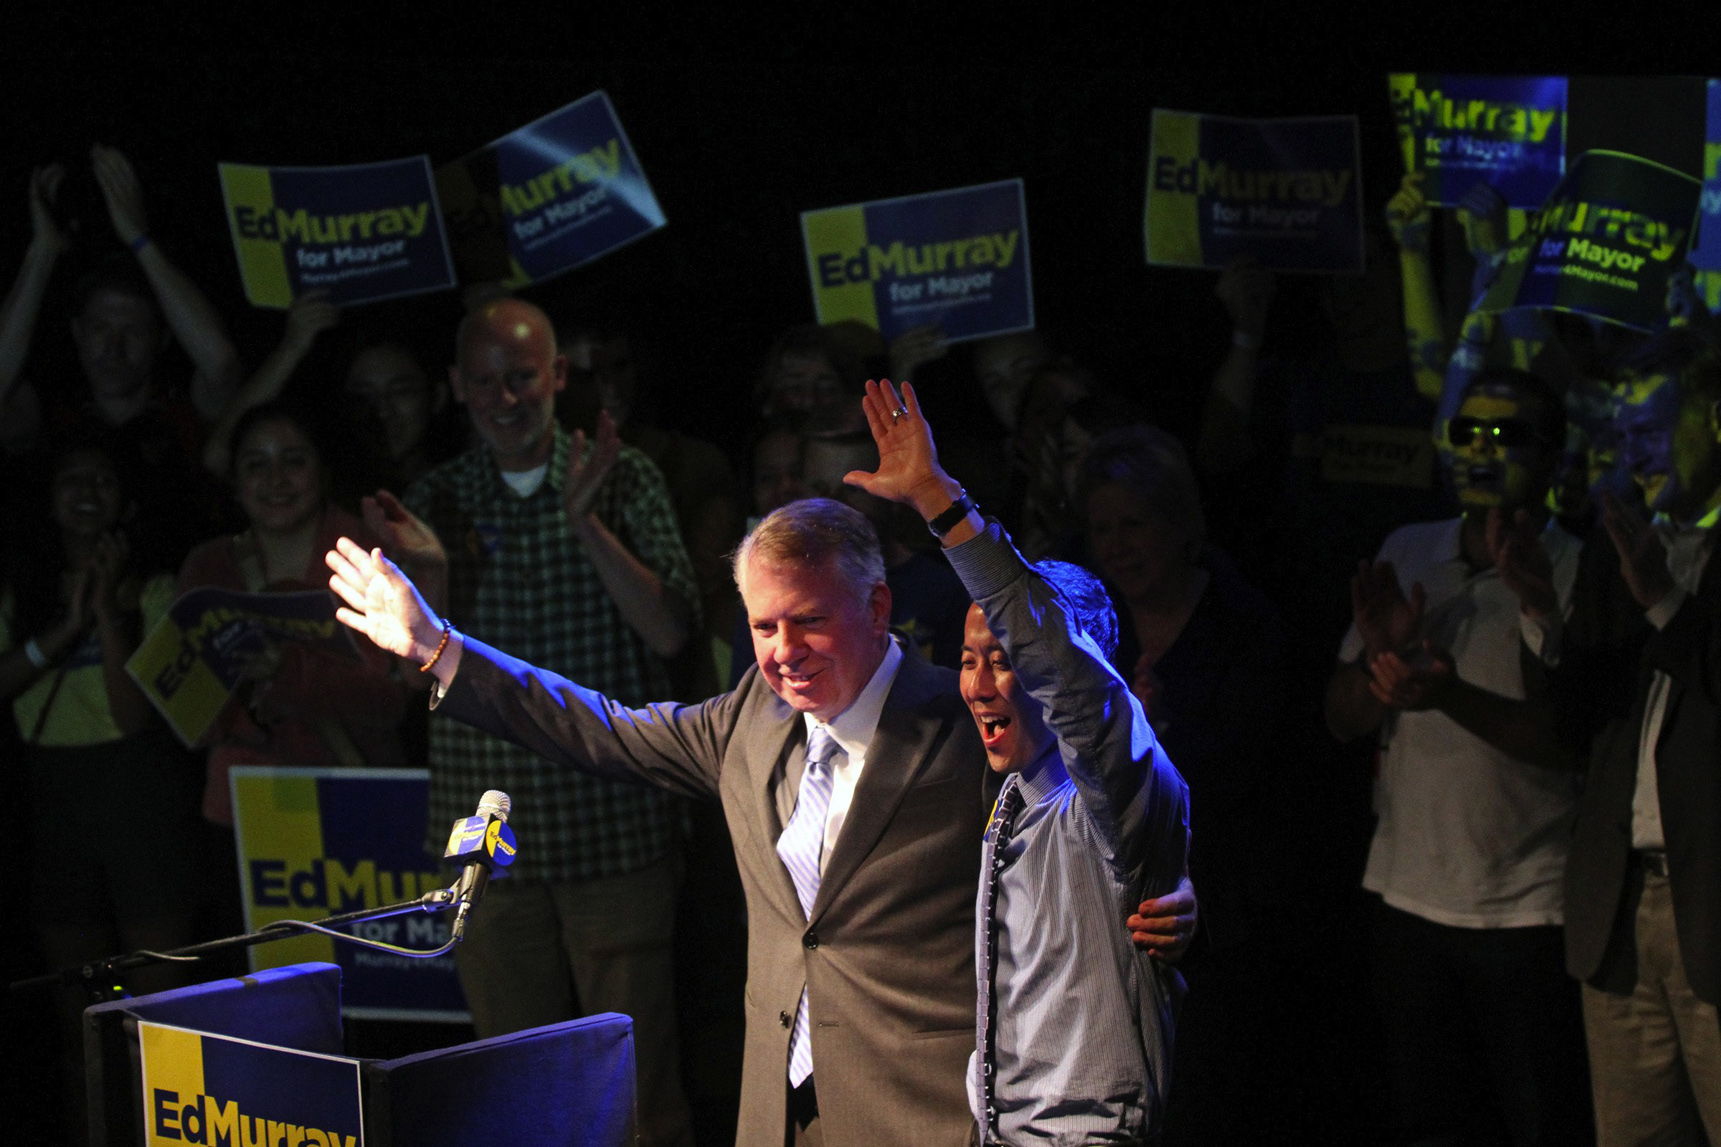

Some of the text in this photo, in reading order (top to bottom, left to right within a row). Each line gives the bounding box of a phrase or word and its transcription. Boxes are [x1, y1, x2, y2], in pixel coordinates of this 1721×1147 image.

[235, 201, 430, 245] EdMurray
[544, 185, 609, 224] Mayor
[296, 239, 407, 268] for Mayor
[818, 228, 1020, 288] EdMurray
[1566, 237, 1647, 273] Mayor
[888, 271, 995, 302] for Mayor
